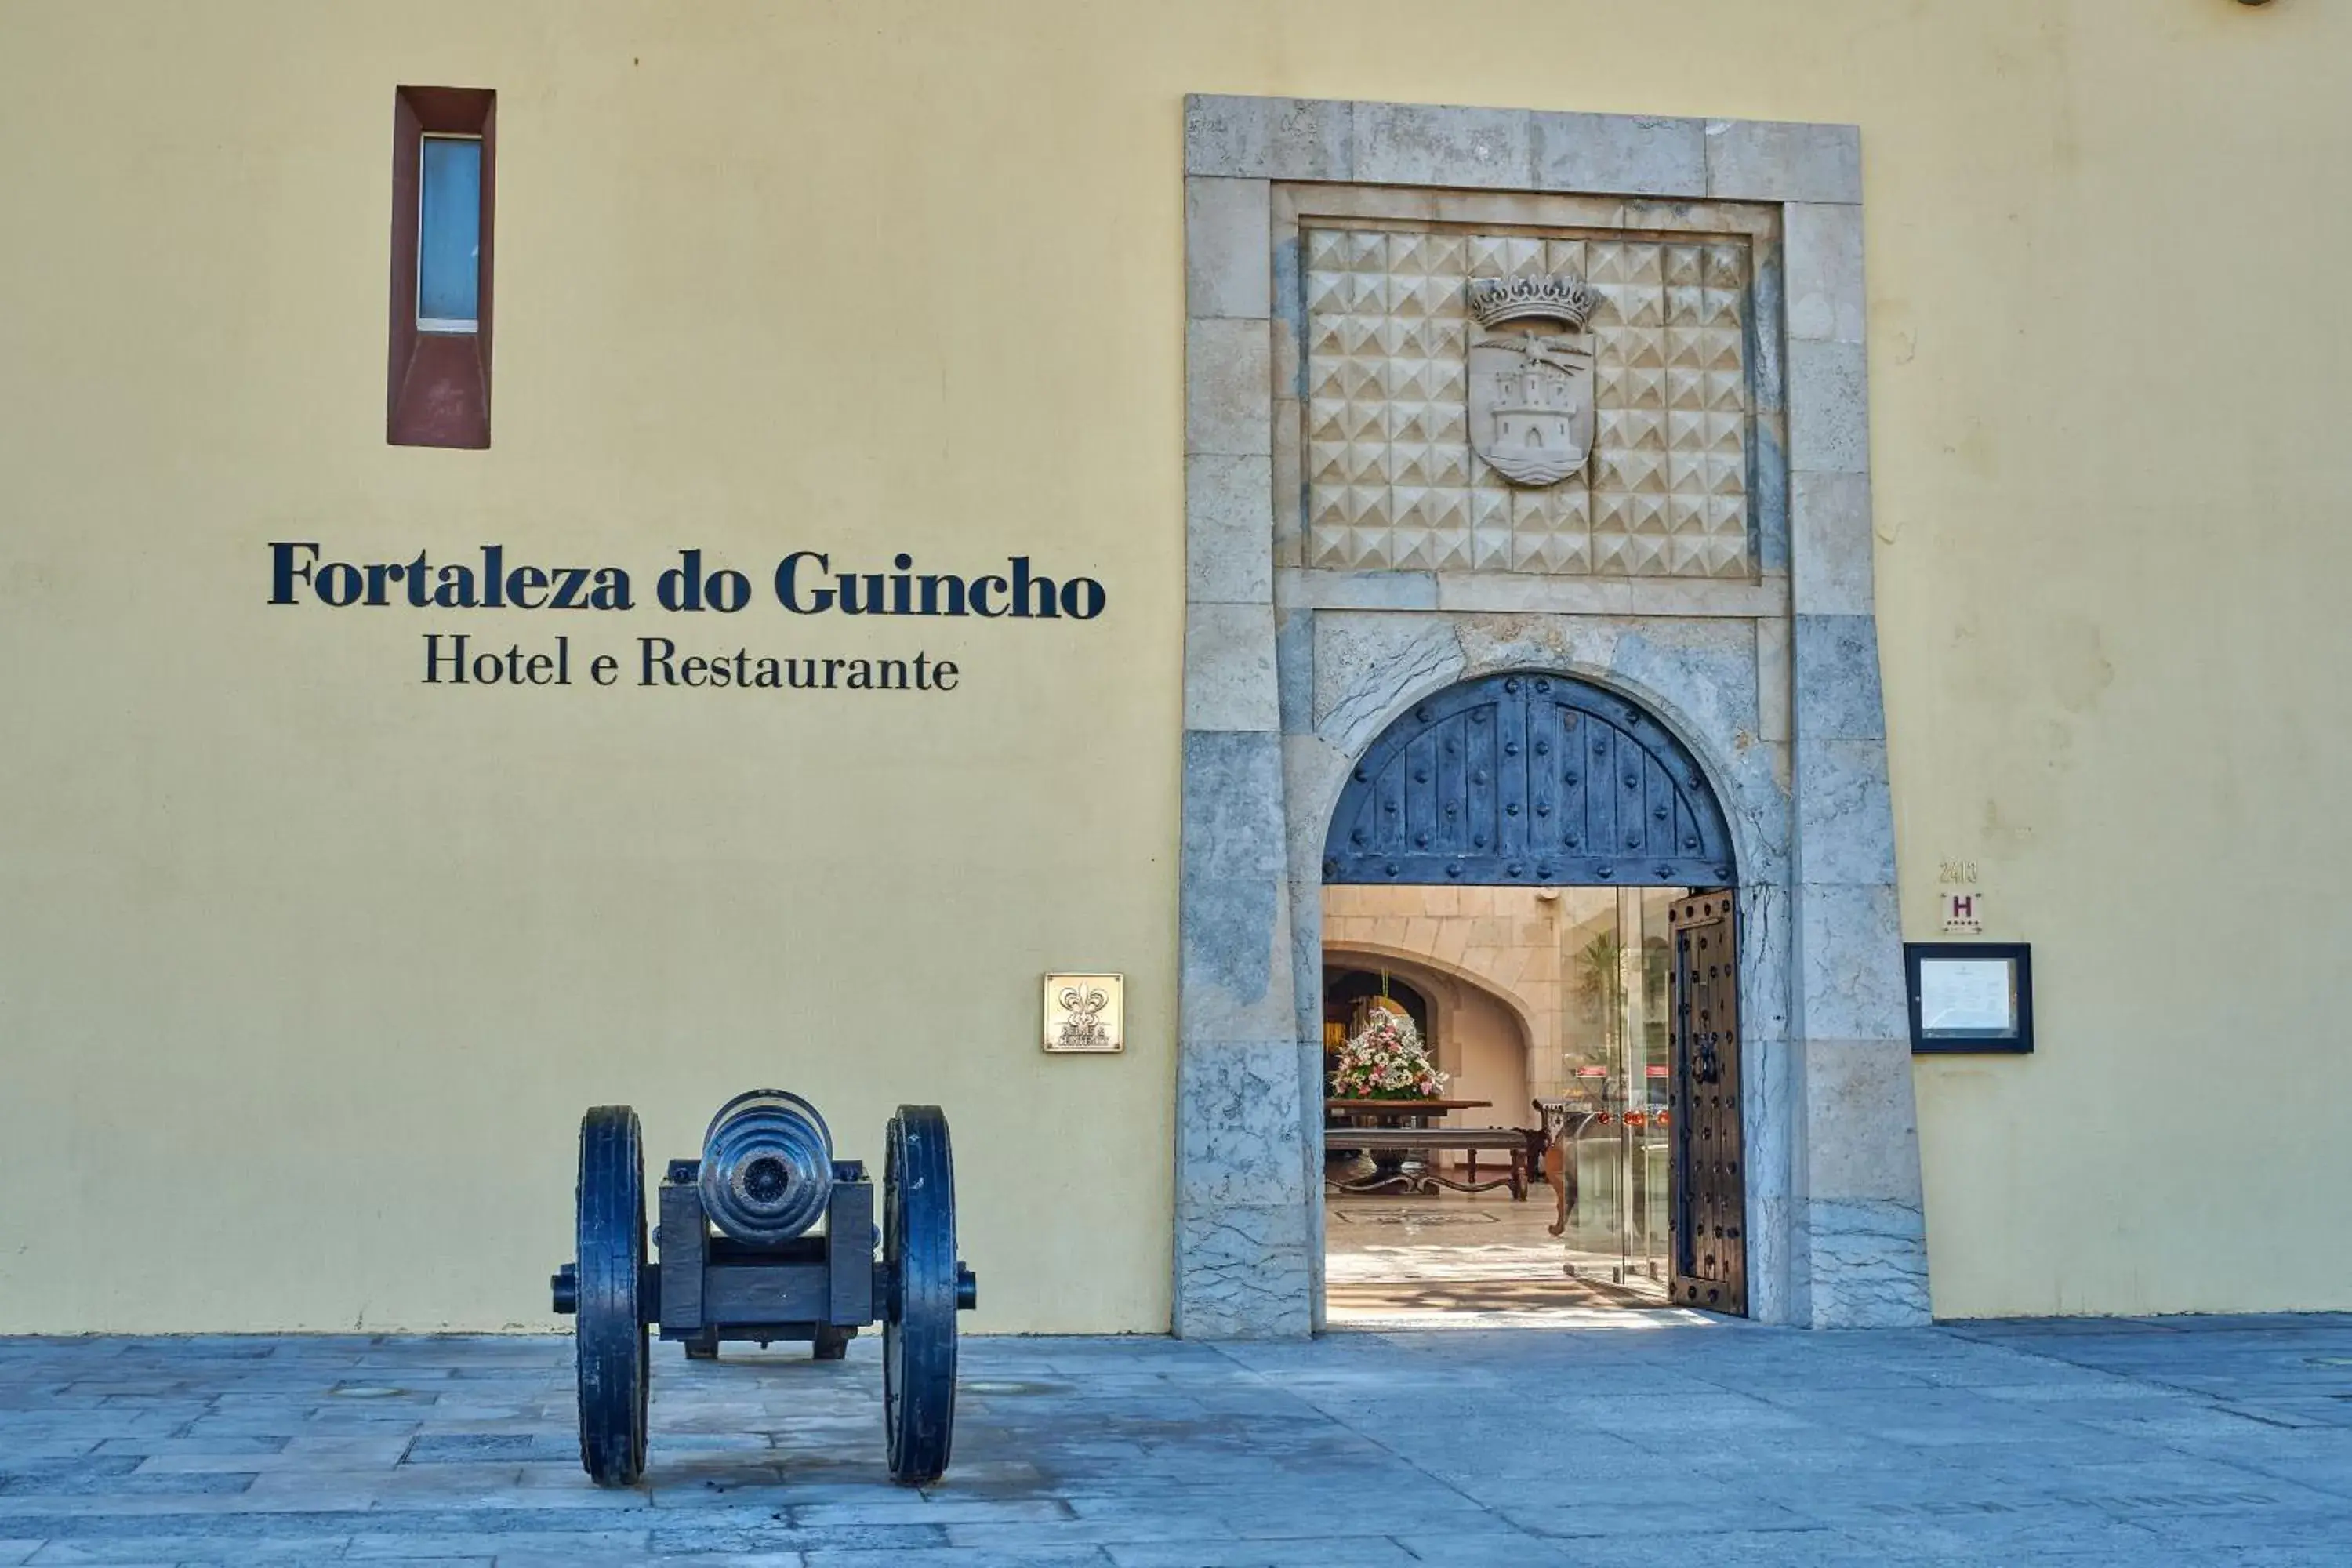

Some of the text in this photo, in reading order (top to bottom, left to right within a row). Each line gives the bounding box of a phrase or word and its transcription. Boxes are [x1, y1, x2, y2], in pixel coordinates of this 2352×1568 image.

[267, 542, 1107, 620] Fortaleza do Guincho
[421, 633, 960, 691] Hotel e Restaurante
[1953, 895, 1972, 918] H
